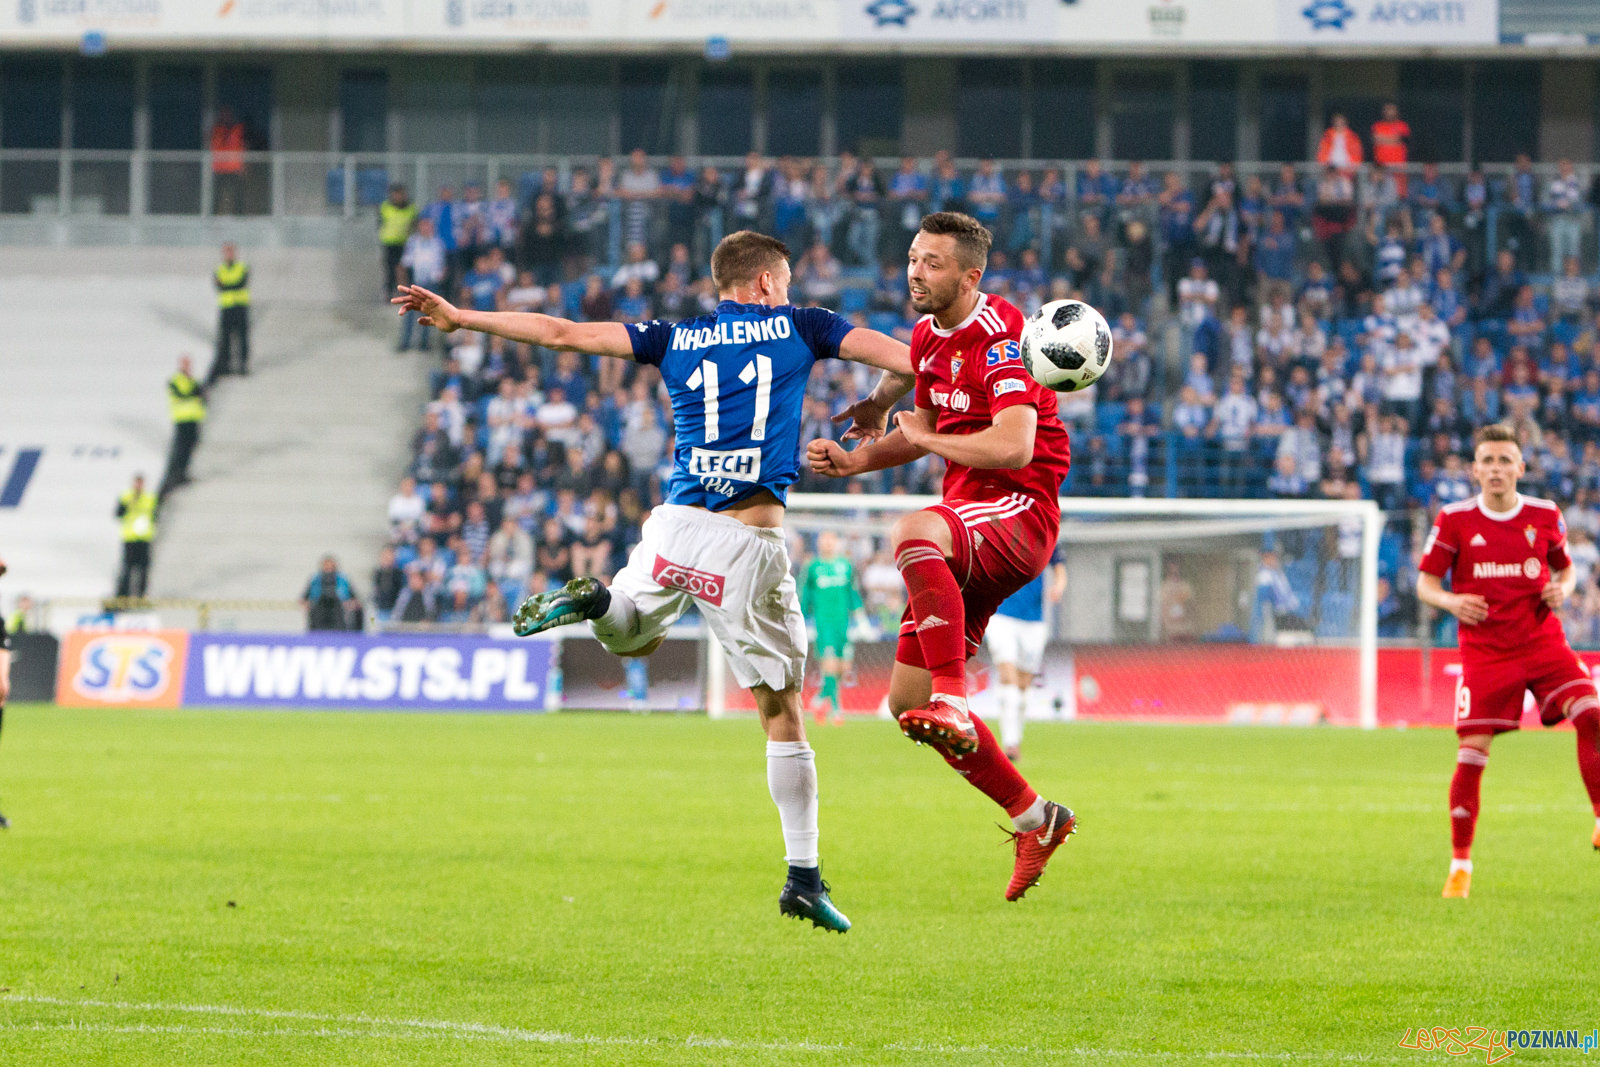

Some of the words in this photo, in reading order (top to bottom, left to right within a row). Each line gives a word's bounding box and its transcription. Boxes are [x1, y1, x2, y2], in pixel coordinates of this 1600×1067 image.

[672, 315, 791, 351] KHOBLENKO
[987, 339, 1021, 366] STS
[685, 353, 772, 443] 11
[696, 455, 754, 475] LECH
[700, 475, 738, 497] Pils
[1473, 561, 1522, 579] Allianz
[80, 642, 168, 692] STS
[202, 644, 539, 700] WWW.STS.PL
